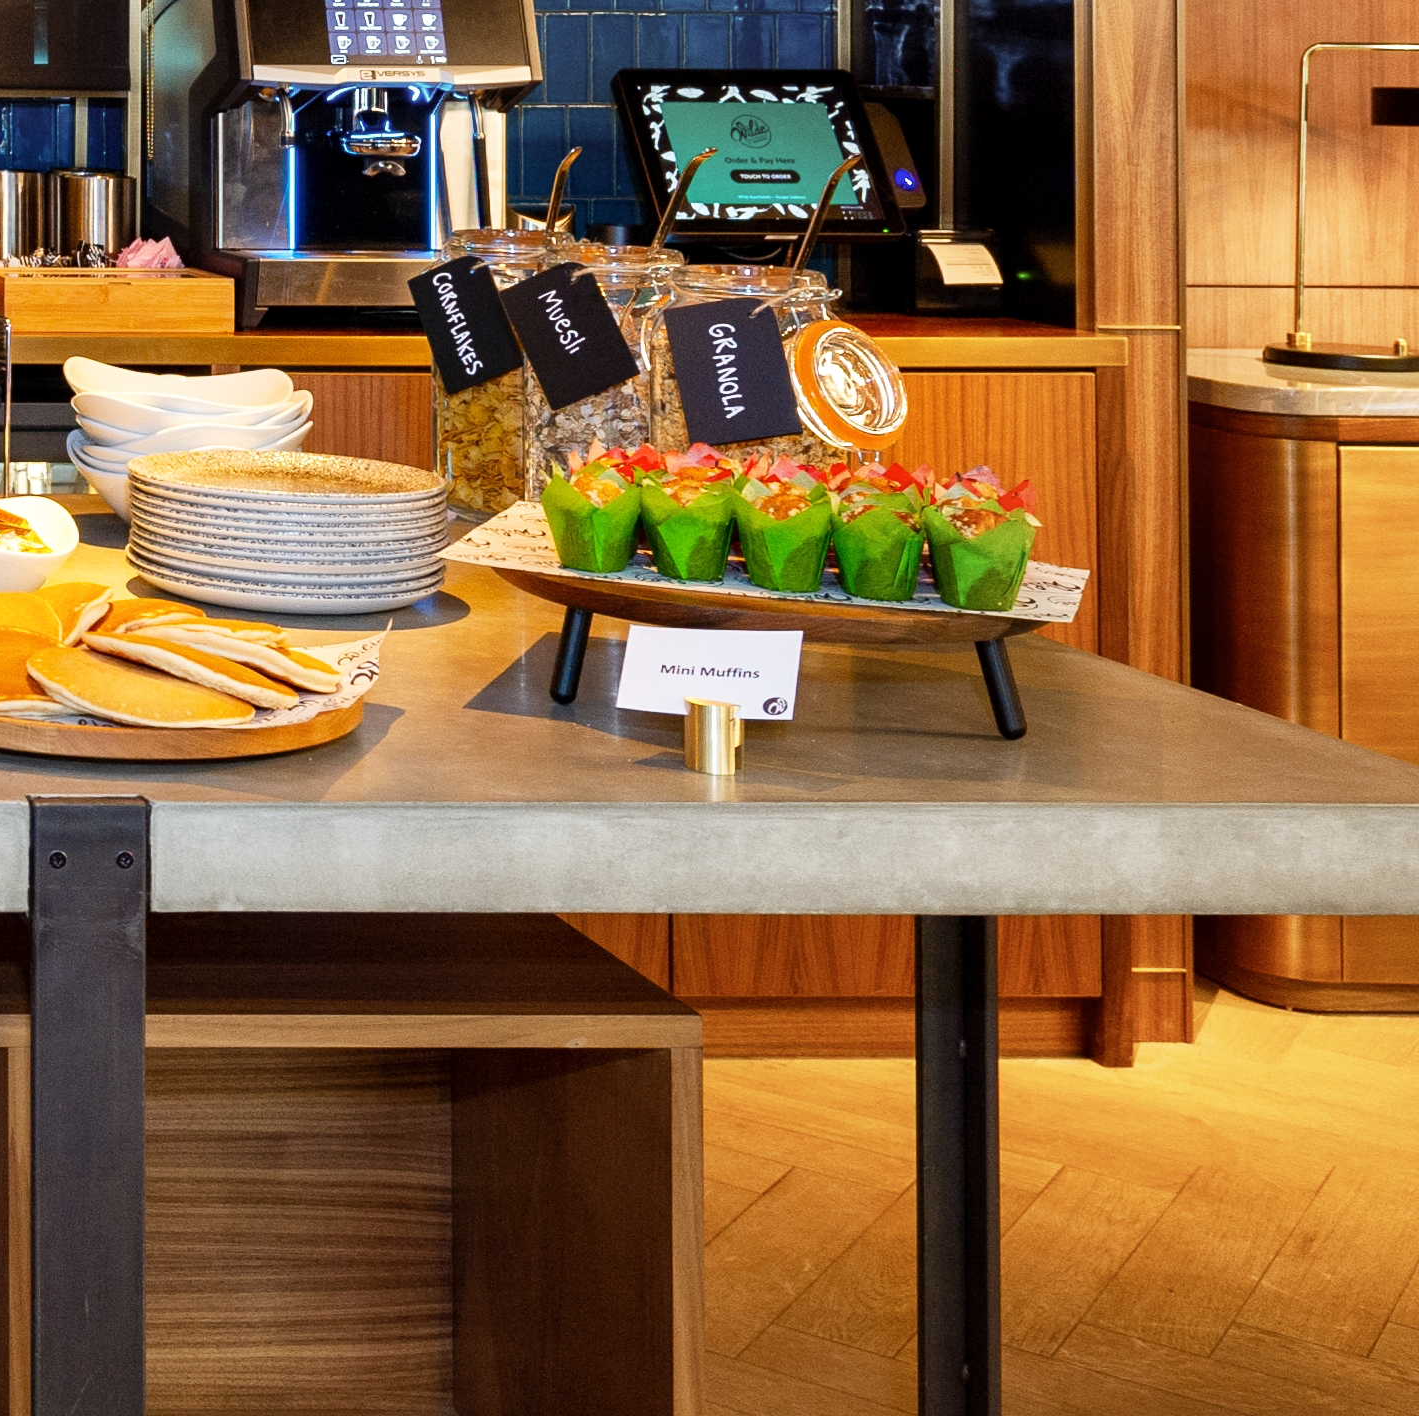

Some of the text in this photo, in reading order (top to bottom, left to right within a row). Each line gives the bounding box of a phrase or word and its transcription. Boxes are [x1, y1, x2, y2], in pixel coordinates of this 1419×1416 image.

[730, 119, 770, 142] Wilde
[759, 157, 774, 165] Pay
[432, 272, 484, 376] CORNFLAKES
[708, 322, 746, 419] GRANOLA
[660, 664, 760, 679] Mini Muffins
